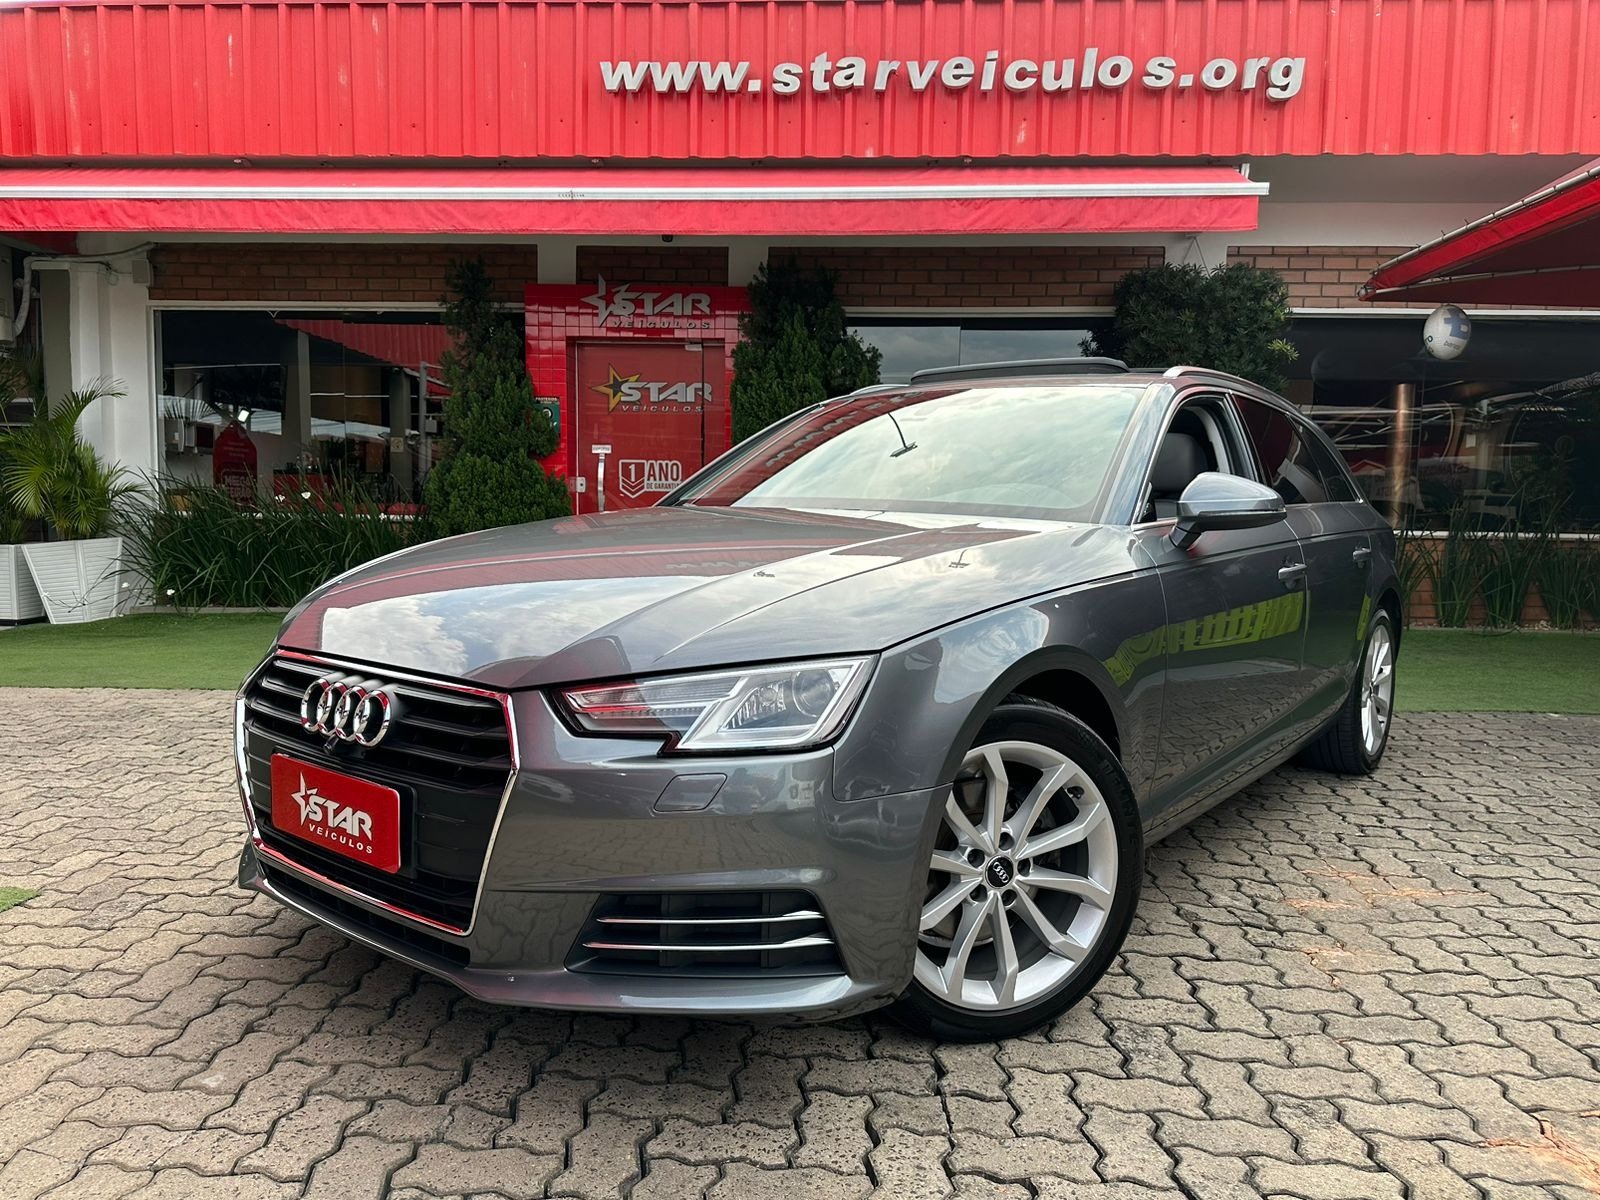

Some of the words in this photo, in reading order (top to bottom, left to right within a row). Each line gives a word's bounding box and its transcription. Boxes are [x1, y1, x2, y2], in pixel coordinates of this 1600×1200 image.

[600, 47, 1306, 102] www.starveiculos.org
[611, 291, 711, 316] STAR
[620, 381, 712, 403] STAR
[628, 464, 636, 482] 1
[647, 461, 681, 482] ANO
[307, 794, 373, 841] STAR
